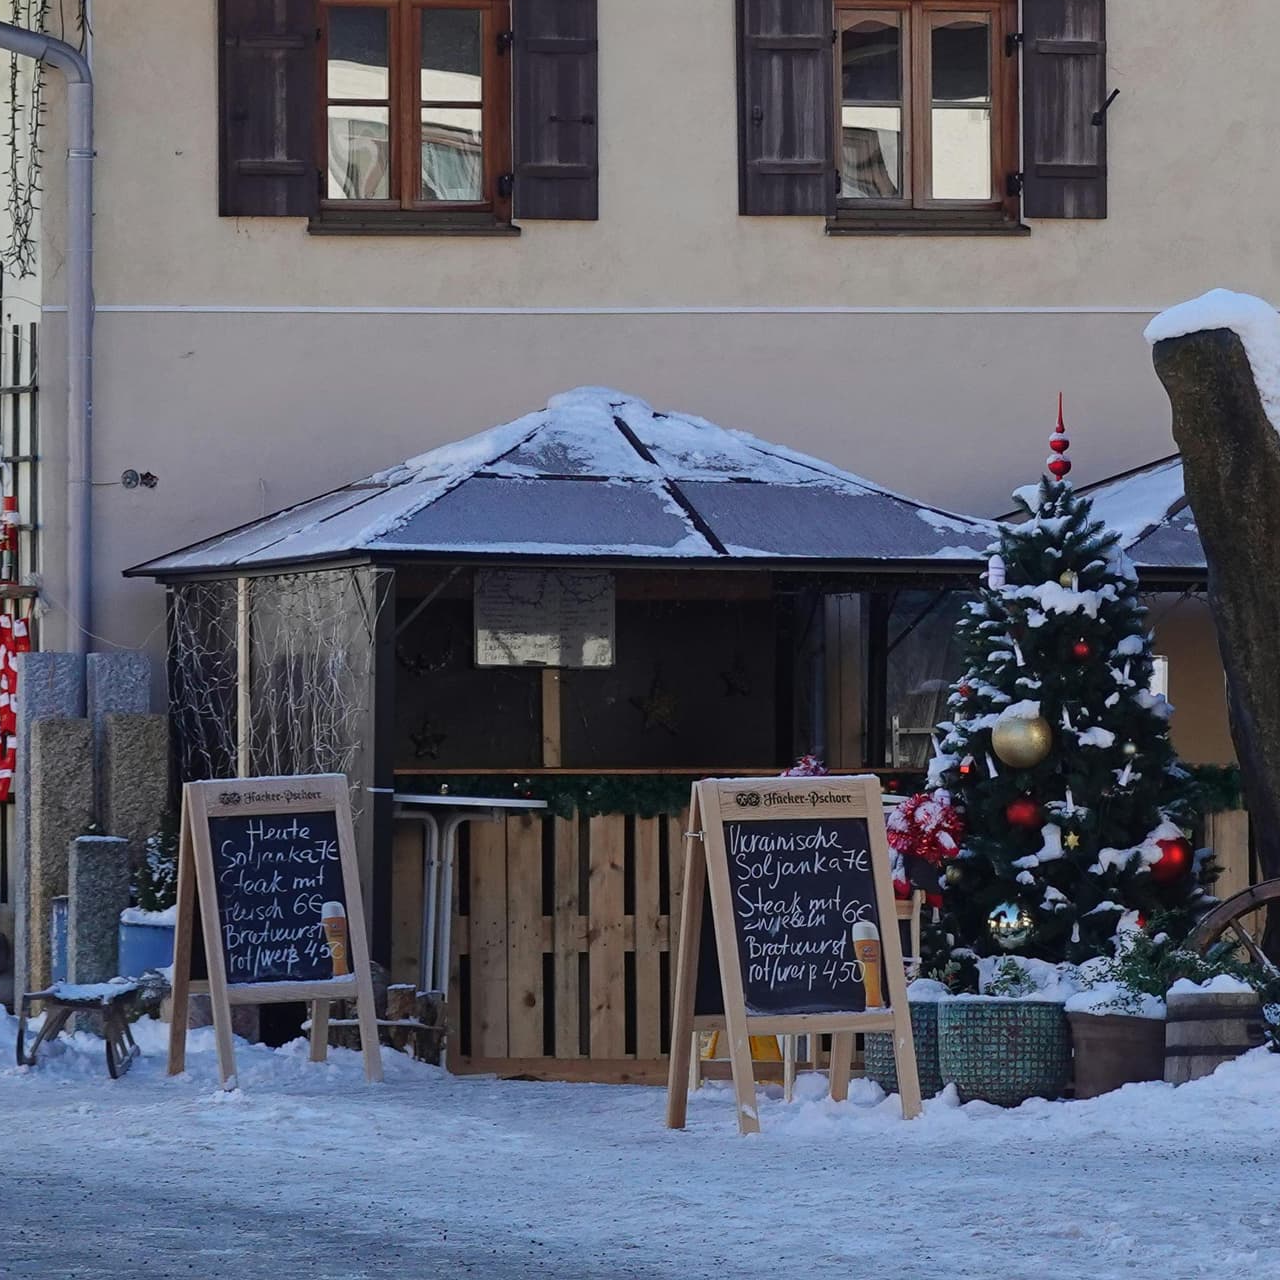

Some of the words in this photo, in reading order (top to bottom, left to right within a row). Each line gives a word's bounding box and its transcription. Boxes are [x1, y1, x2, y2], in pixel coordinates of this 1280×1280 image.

[763, 791, 852, 807] Hacker-Pschorr
[246, 818, 310, 840] Heute
[220, 869, 287, 898] Steak
[292, 865, 324, 889] mit
[735, 852, 843, 889] Soljanka
[737, 883, 802, 917] Steak
[809, 885, 841, 911] mit
[842, 899, 872, 923] 6€
[223, 921, 328, 950] Bratwurst
[745, 929, 846, 960] Bratwurst
[822, 960, 866, 990] 4,50
